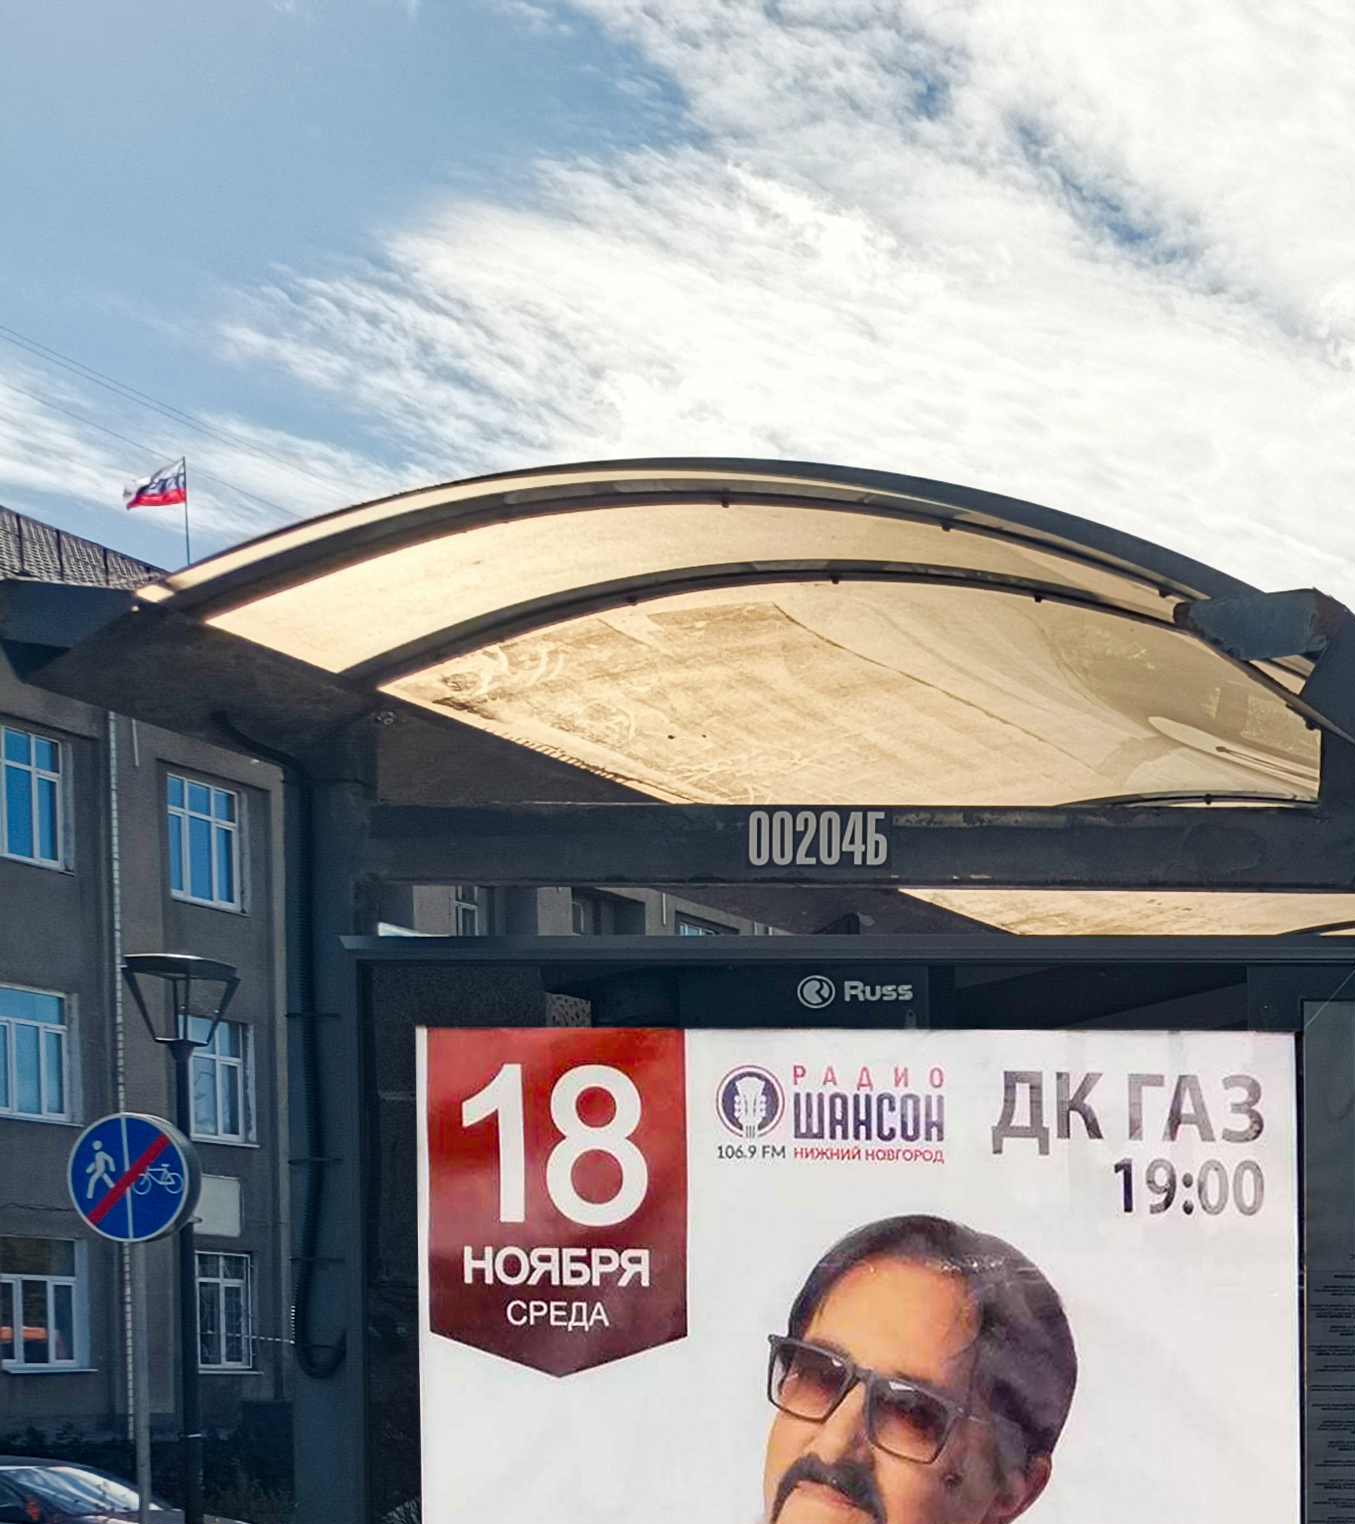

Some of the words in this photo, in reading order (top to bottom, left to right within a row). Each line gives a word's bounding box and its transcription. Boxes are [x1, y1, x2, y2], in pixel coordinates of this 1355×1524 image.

[748, 811, 888, 867] 00204Б
[844, 981, 913, 1001] Russ
[793, 1065, 944, 1091] РАДИО
[793, 1092, 944, 1142] ШАНСОН
[991, 1070, 1101, 1154] ДК
[1127, 1072, 1265, 1143] ГАЗ
[460, 1062, 649, 1227] 18
[718, 1145, 756, 1160] 106.9
[762, 1145, 785, 1160] FM
[794, 1145, 861, 1162] НИЖНИЙ
[865, 1148, 944, 1164] НОВГОРОД
[1113, 1157, 1265, 1217] 19:00
[463, 1246, 650, 1288] НОЯБРЯ
[506, 1299, 609, 1330] СРЕДА
